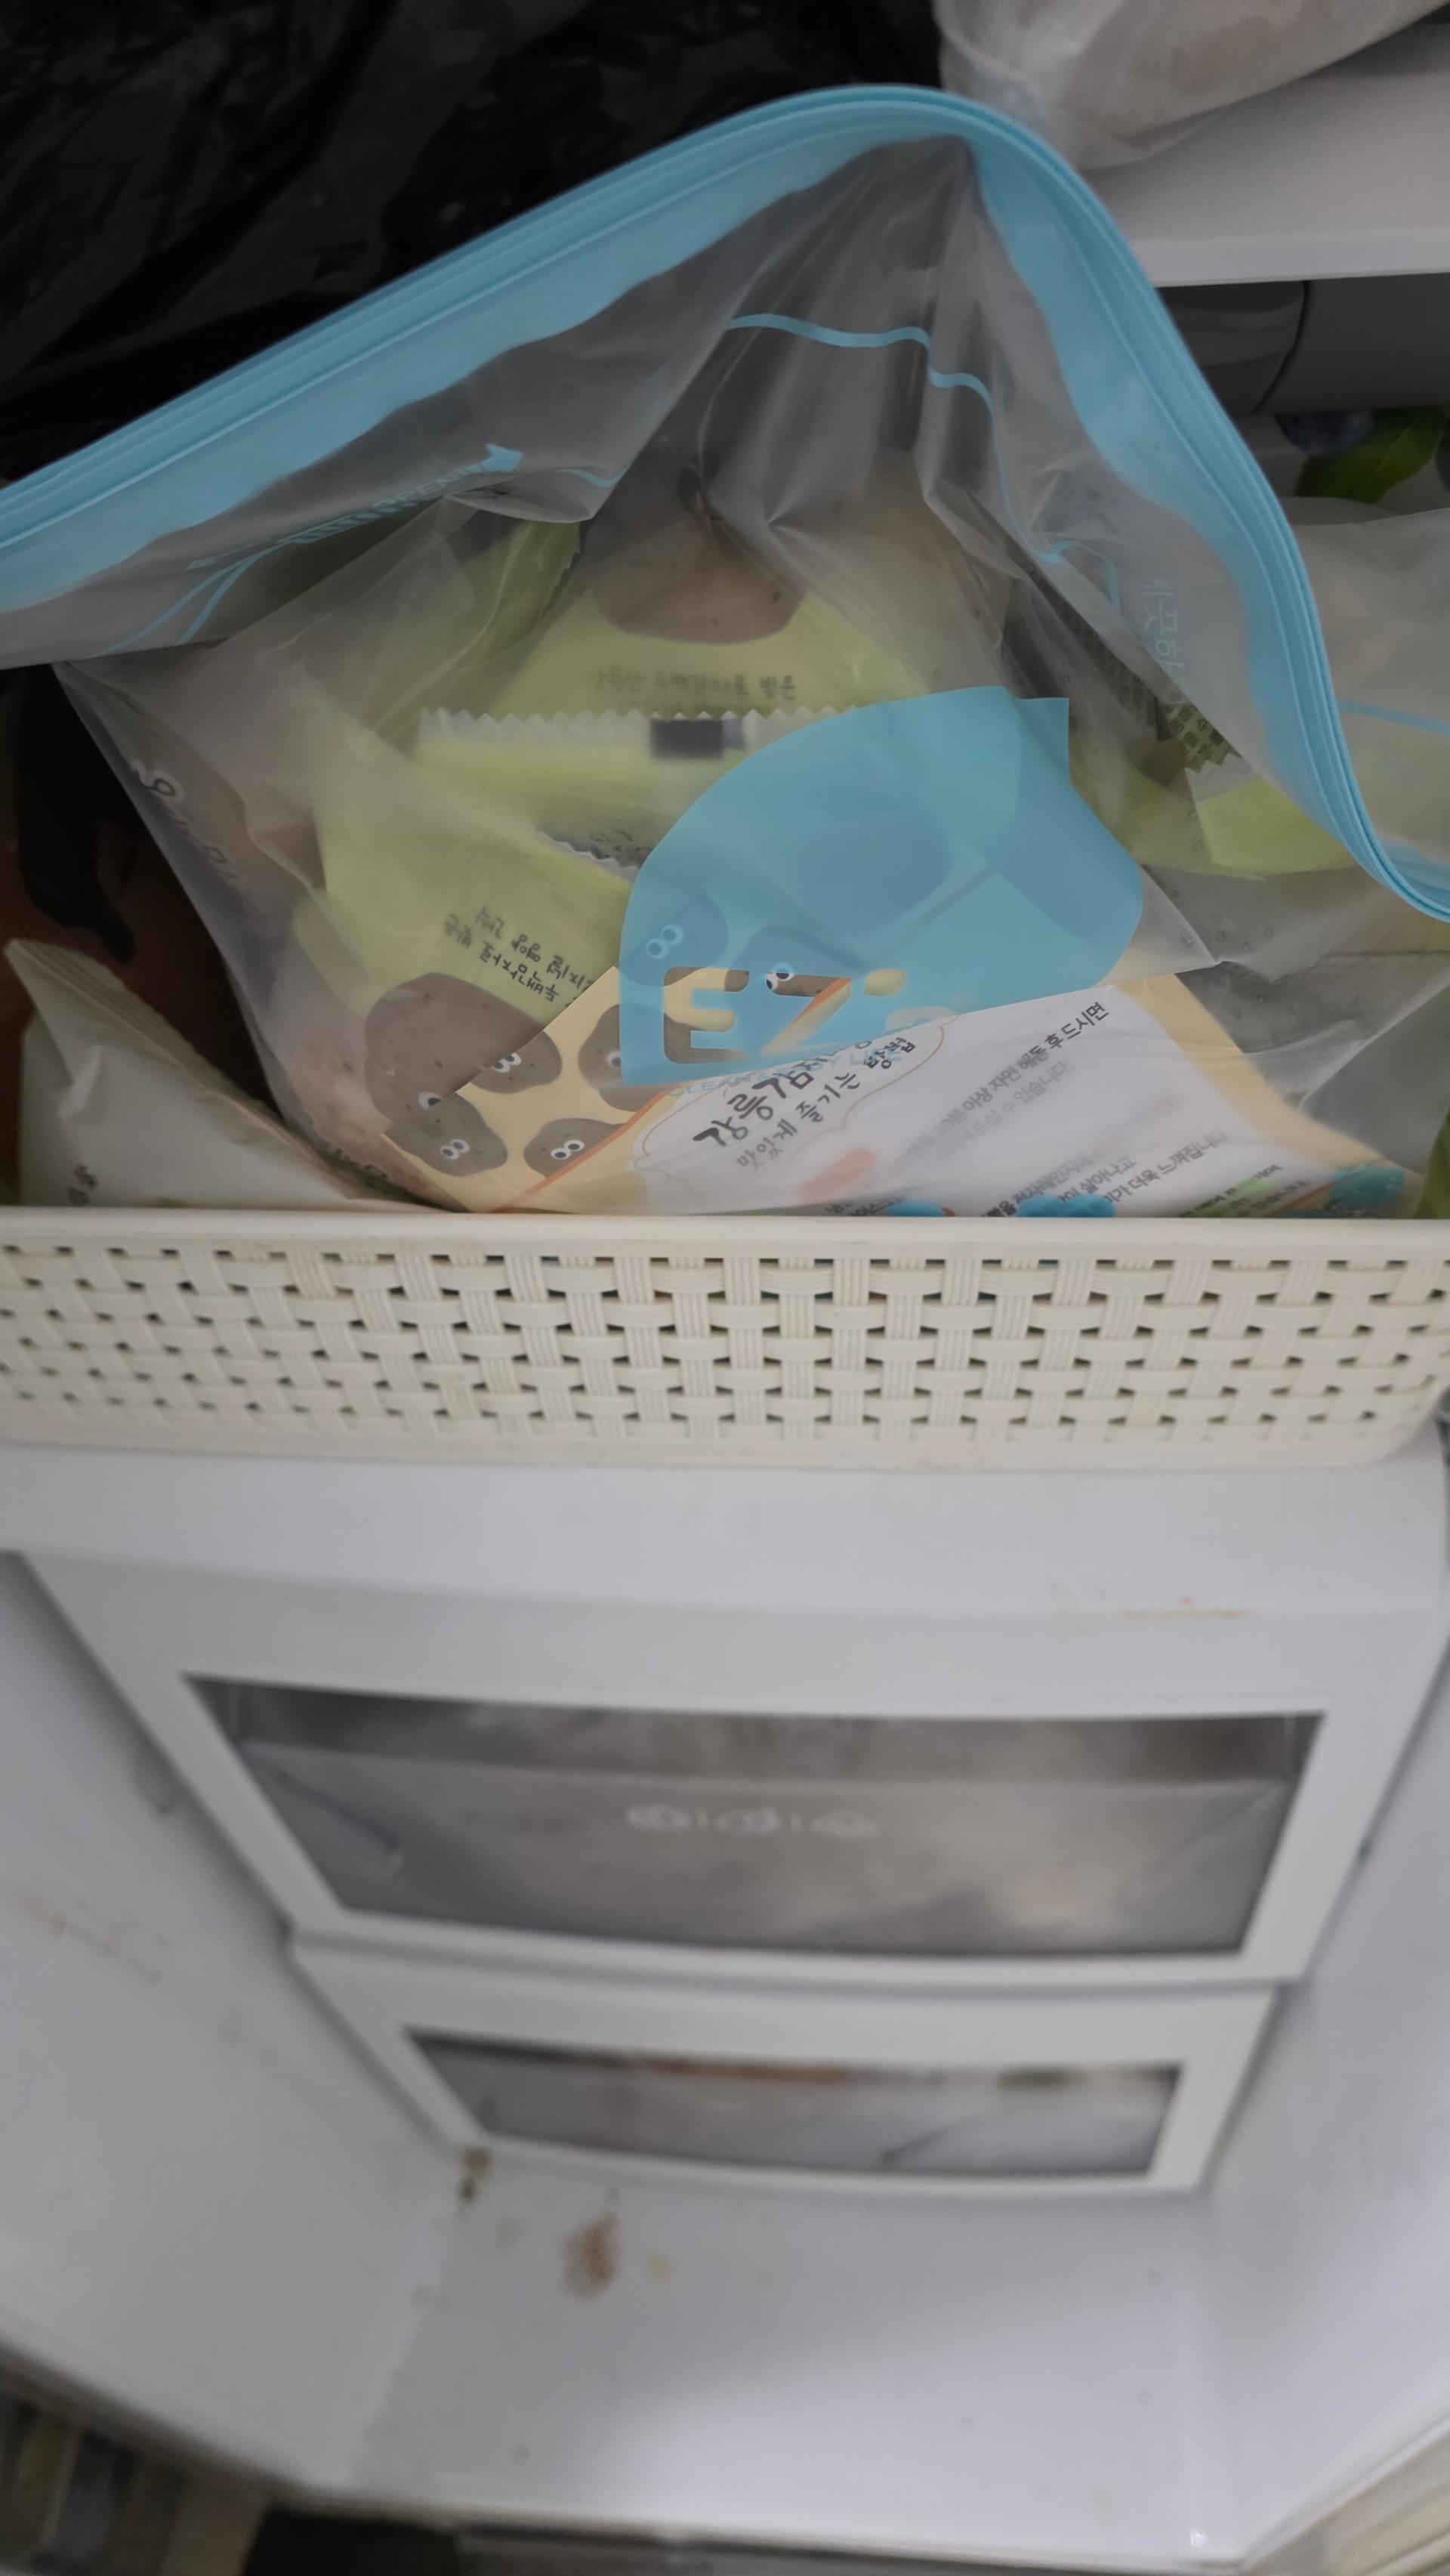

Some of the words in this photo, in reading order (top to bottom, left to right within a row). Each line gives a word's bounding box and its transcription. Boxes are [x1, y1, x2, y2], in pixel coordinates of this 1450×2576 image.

[511, 933, 541, 971] 영양
[1044, 1033, 1064, 1049] 후
[1060, 1001, 1109, 1039] 드시면
[795, 1073, 861, 1123] 즐기는
[863, 1036, 917, 1070] 방법
[1128, 1169, 1161, 1190] 더욱
